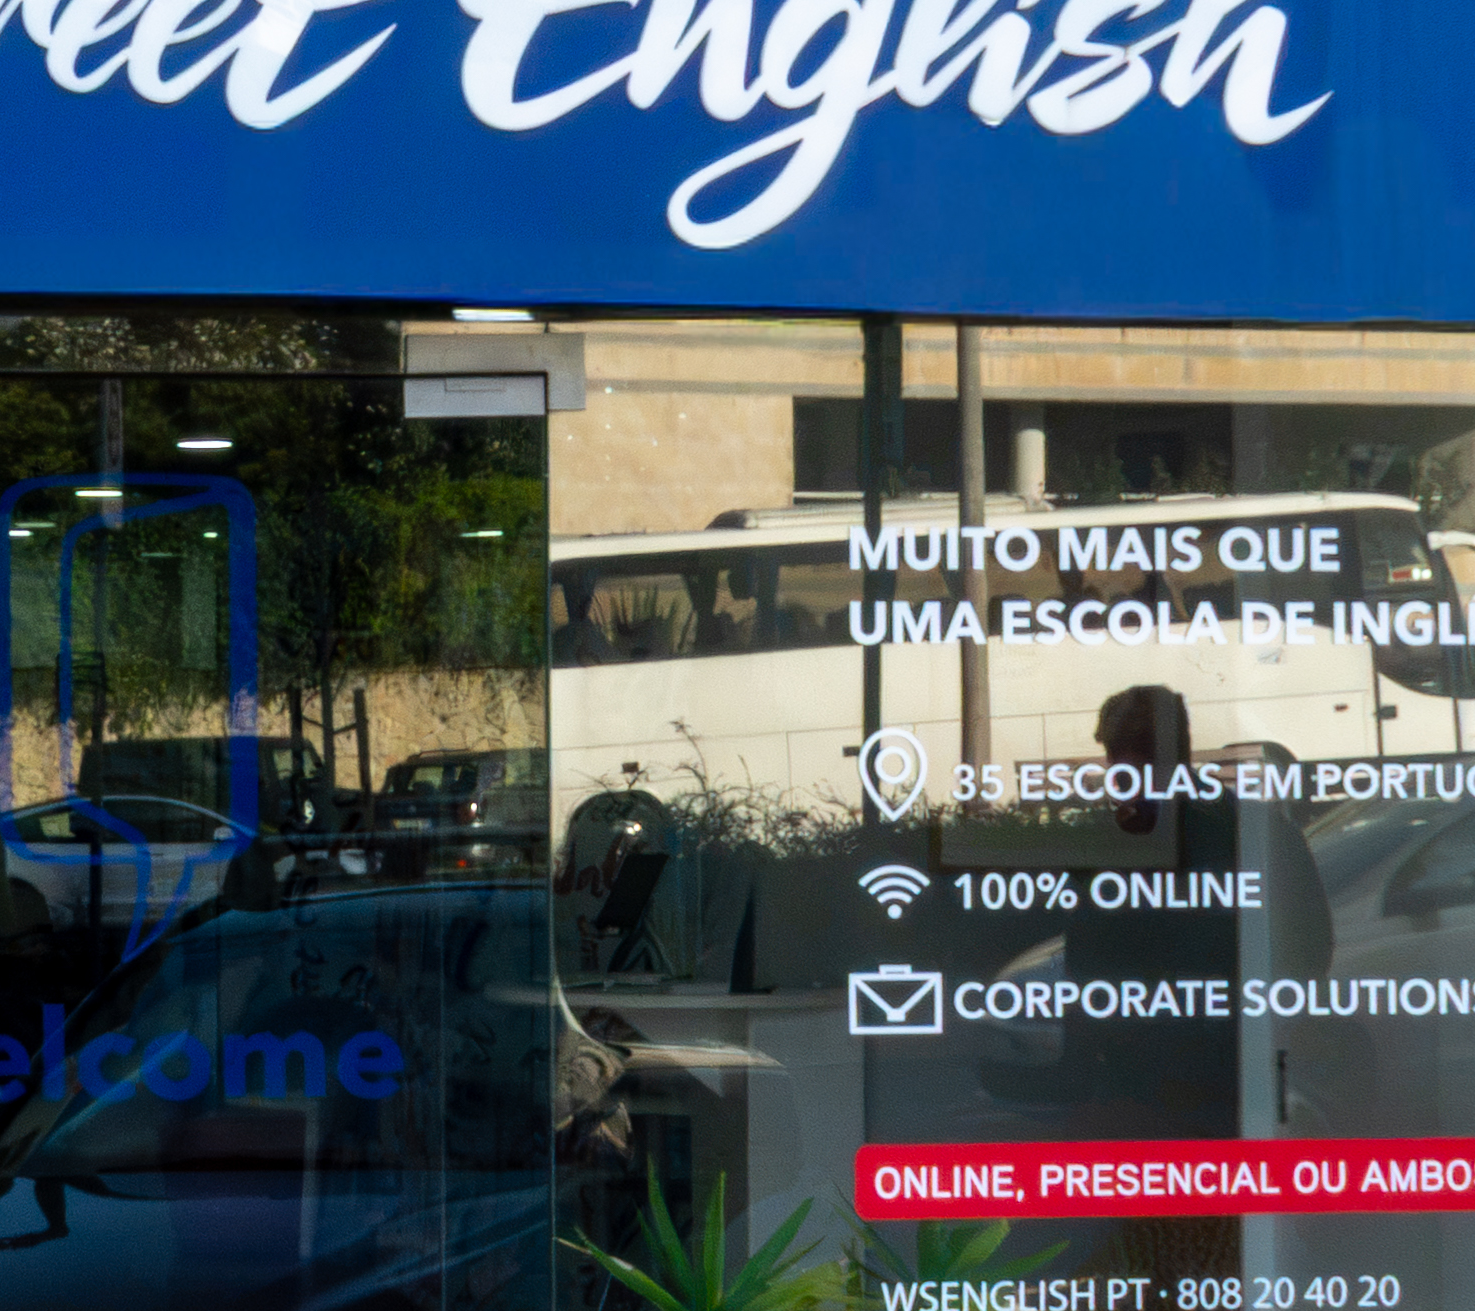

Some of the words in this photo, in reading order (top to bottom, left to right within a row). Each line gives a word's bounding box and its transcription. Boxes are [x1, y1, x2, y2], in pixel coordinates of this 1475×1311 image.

[848, 526, 1040, 572] MUITO
[1057, 527, 1204, 573] MAIS
[1218, 527, 1341, 575] QUE
[849, 600, 988, 647] UMA
[1000, 600, 1227, 646] ESCOLA
[1239, 600, 1316, 646] DE
[950, 762, 1006, 801] 35
[1019, 762, 1223, 801] ESCOLAS
[1236, 763, 1301, 800] EM
[953, 872, 1079, 910] 100%
[1090, 872, 1263, 909] ONLINE
[953, 981, 1230, 1019] CORPORATE
[873, 1164, 1027, 1203] ONLINE,
[1039, 1161, 1282, 1198] PRESENCIAL
[1293, 1160, 1348, 1195] OU
[1106, 1278, 1151, 1311] PT
[1177, 1277, 1244, 1311] 808
[1252, 1276, 1297, 1310] 20
[1303, 1275, 1350, 1309] 40
[1357, 1274, 1402, 1308] 20
